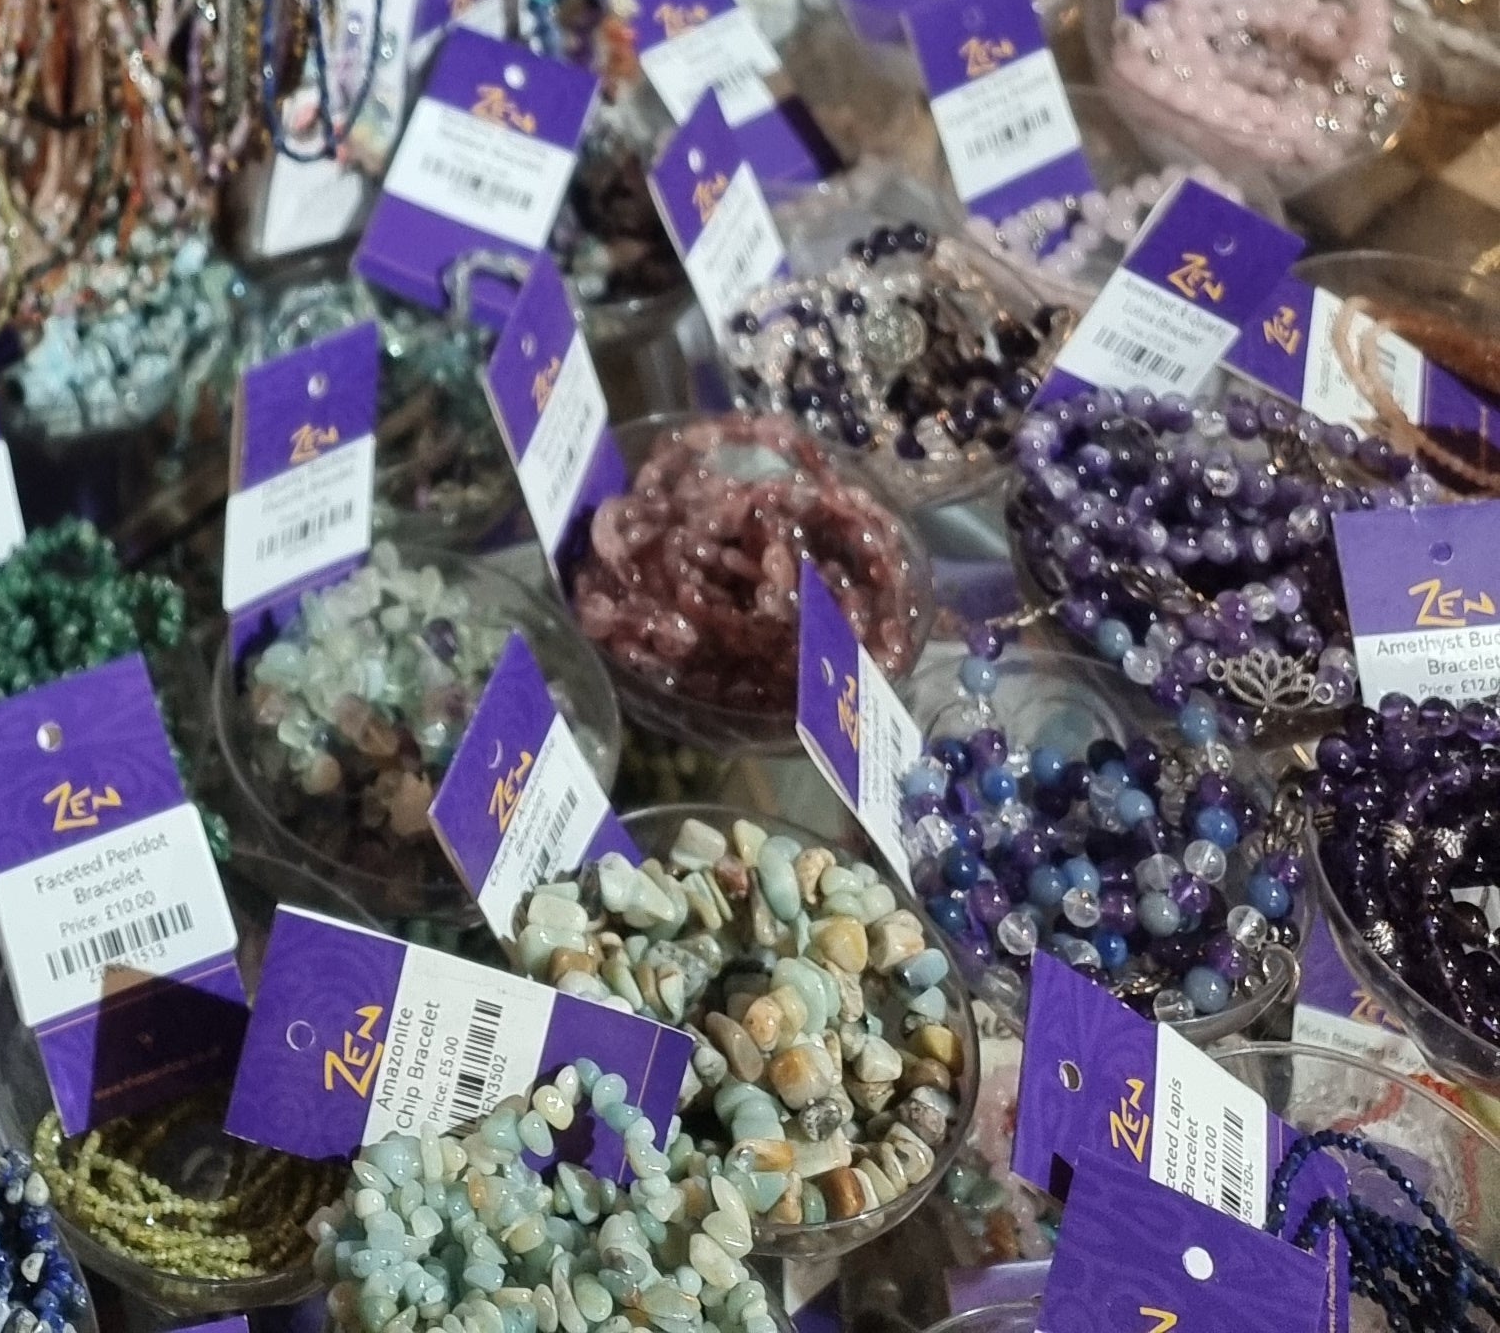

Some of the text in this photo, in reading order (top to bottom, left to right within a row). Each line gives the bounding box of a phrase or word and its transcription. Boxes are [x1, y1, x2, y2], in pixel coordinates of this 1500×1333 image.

[1166, 253, 1226, 303] ZEN
[1408, 579, 1496, 626] ZEN
[1376, 633, 1464, 656] Amethyst
[1427, 654, 1500, 676] Bracelet
[43, 781, 122, 832] ZEN
[488, 750, 534, 834] ZEN
[34, 832, 169, 894] Faceted Peridot
[72, 867, 145, 905] Bracelet
[104, 889, 157, 921] £10.00
[324, 1005, 385, 1099] ZEN
[374, 1006, 415, 1113] Amazonite
[395, 999, 442, 1130] Chip Bracelet
[426, 1035, 460, 1123] Price: £5.00
[479, 1054, 510, 1118] EN3502
[1109, 1078, 1150, 1163] ZEN
[1164, 1076, 1186, 1188] ceted Lapis
[1181, 1115, 1200, 1201] Bracelet
[1202, 1124, 1218, 1186] £10.00
